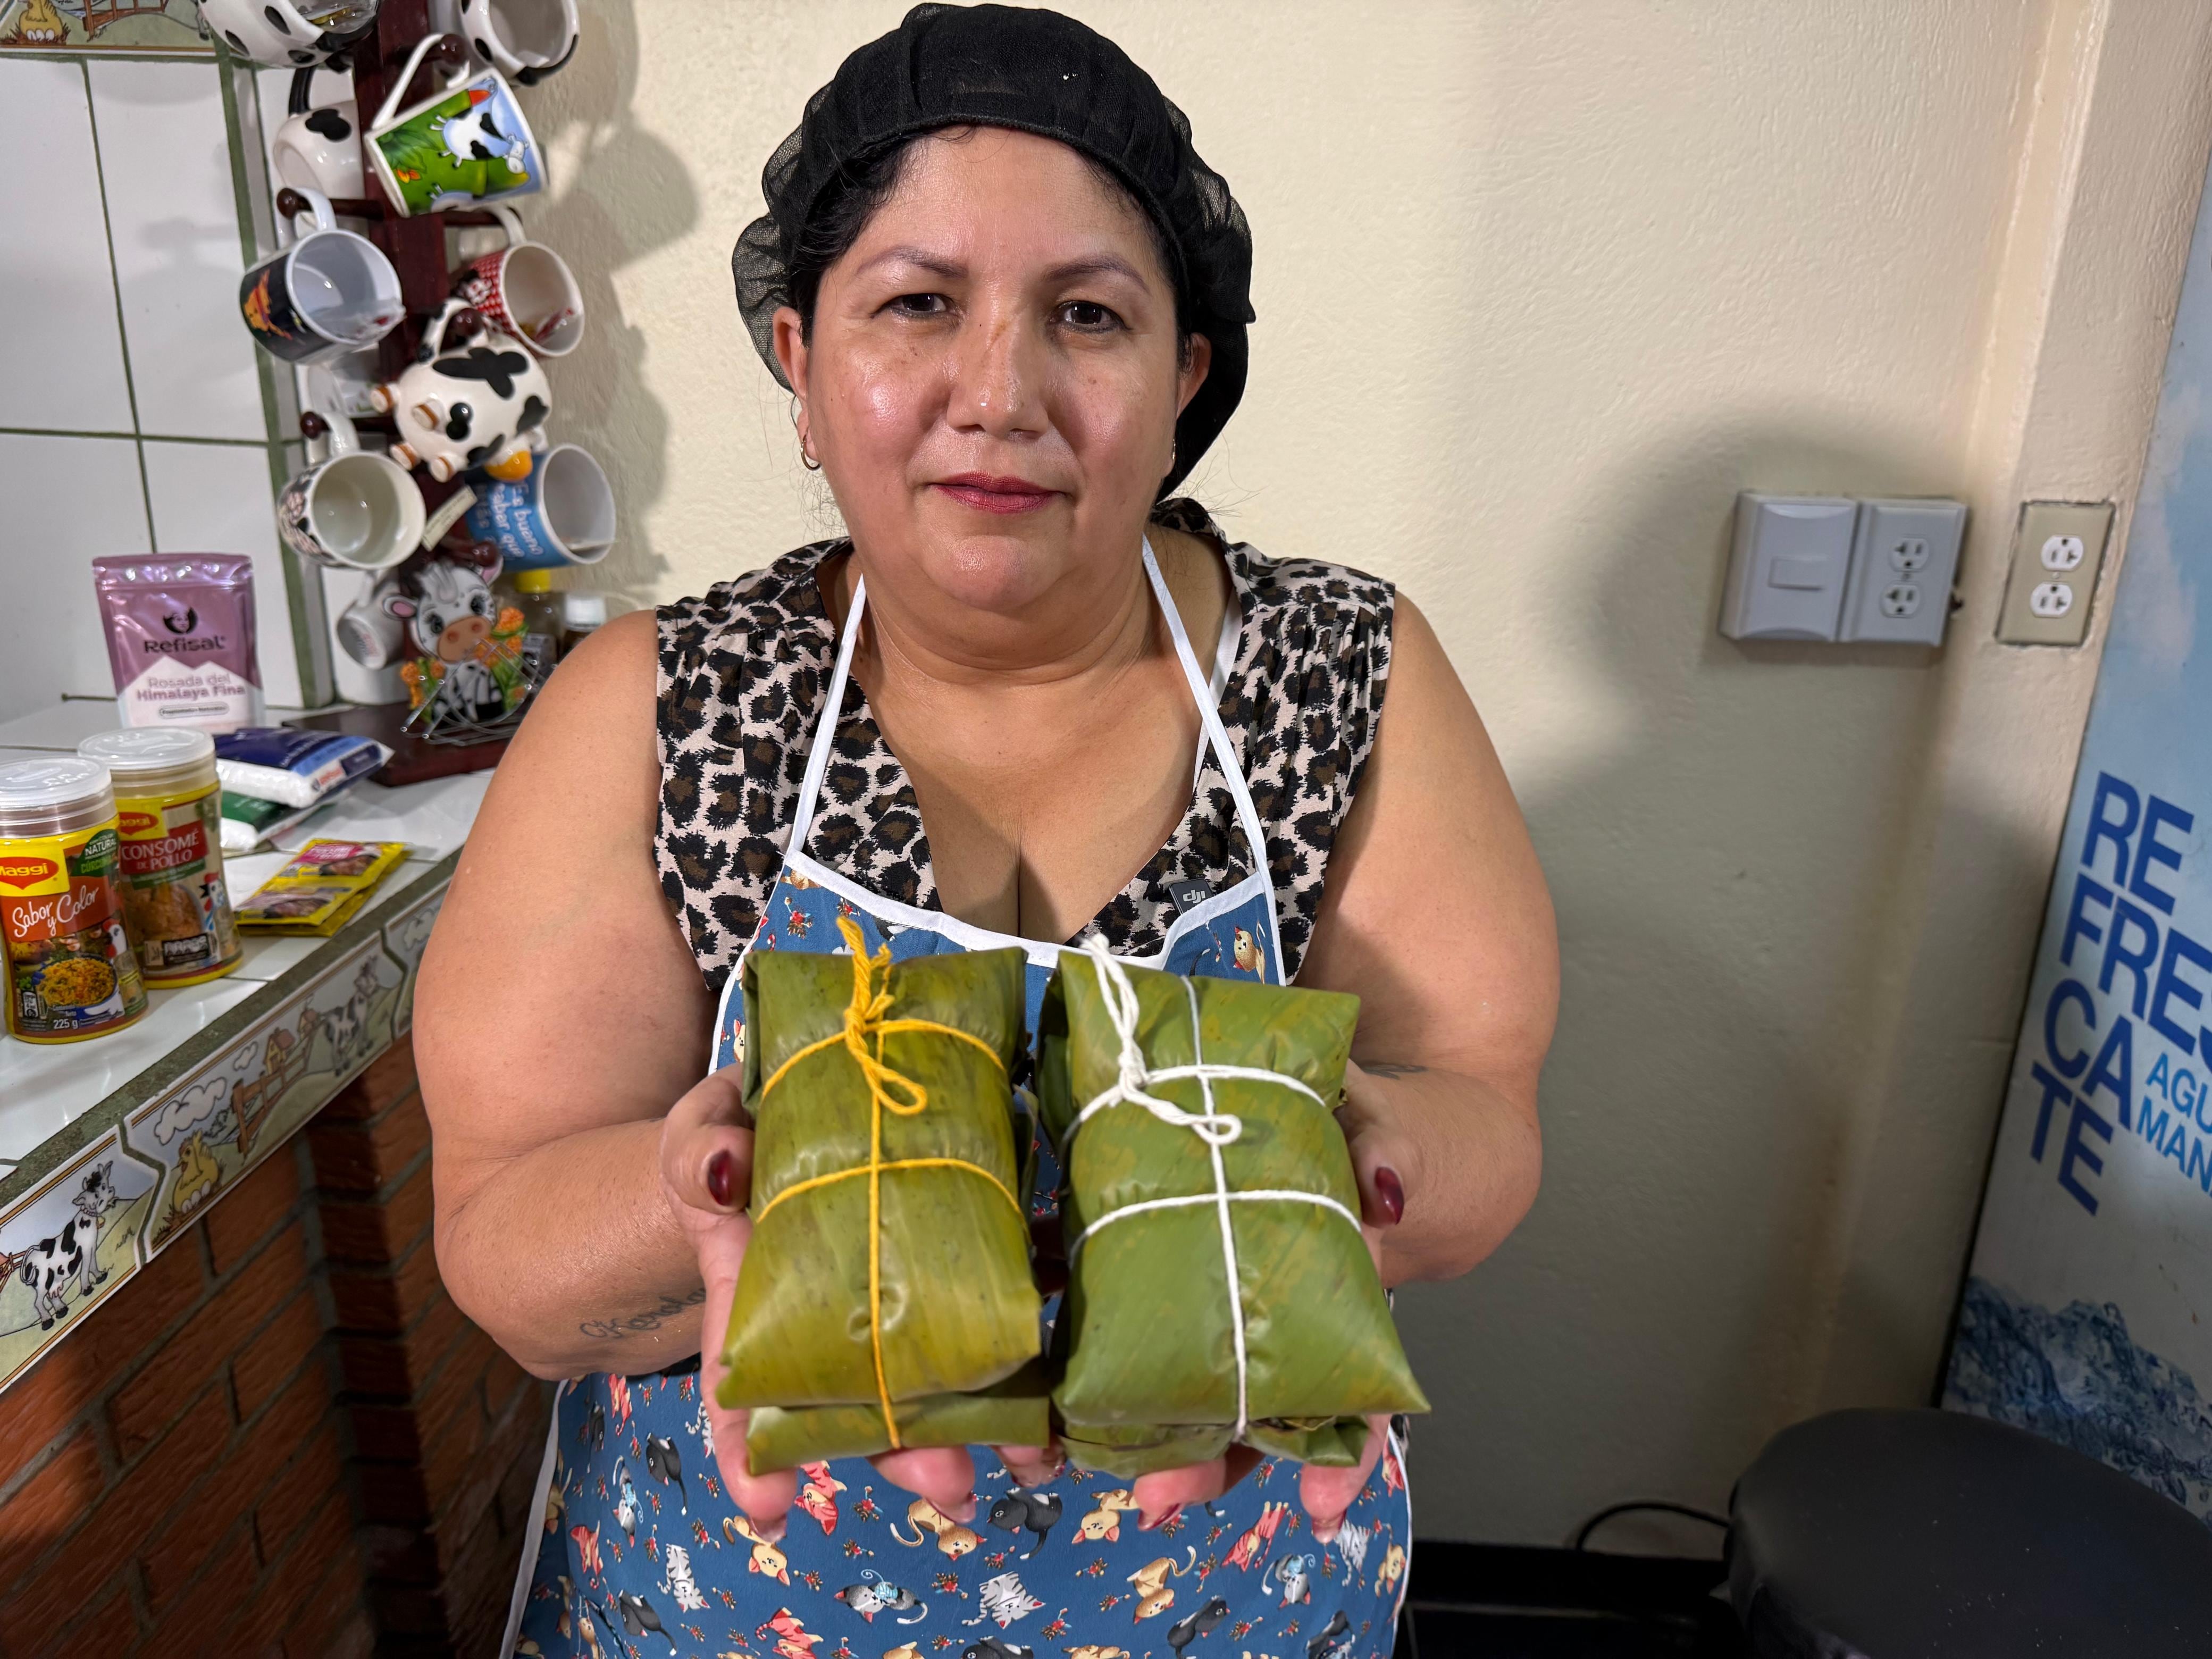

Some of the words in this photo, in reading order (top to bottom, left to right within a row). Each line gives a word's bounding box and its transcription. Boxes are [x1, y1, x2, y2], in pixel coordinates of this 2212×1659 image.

[513, 508, 543, 556] bueno
[144, 636, 222, 653] Refisal
[136, 686, 209, 701] Himalaya
[213, 685, 247, 697] Fina
[148, 675, 203, 688] Rosada
[207, 673, 231, 684] del
[121, 828, 199, 861] CONSOMÉ
[150, 849, 193, 870] POLLO
[2080, 770, 2195, 917] RE
[12, 901, 53, 938] Sabor
[47, 916, 57, 936] y
[56, 885, 99, 923] Color
[53, 1019, 70, 1030] 225
[72, 1019, 79, 1030] g
[2043, 977, 2133, 1132] CA
[2030, 1060, 2114, 1217] TE
[2136, 1094, 2212, 1199] MAN
